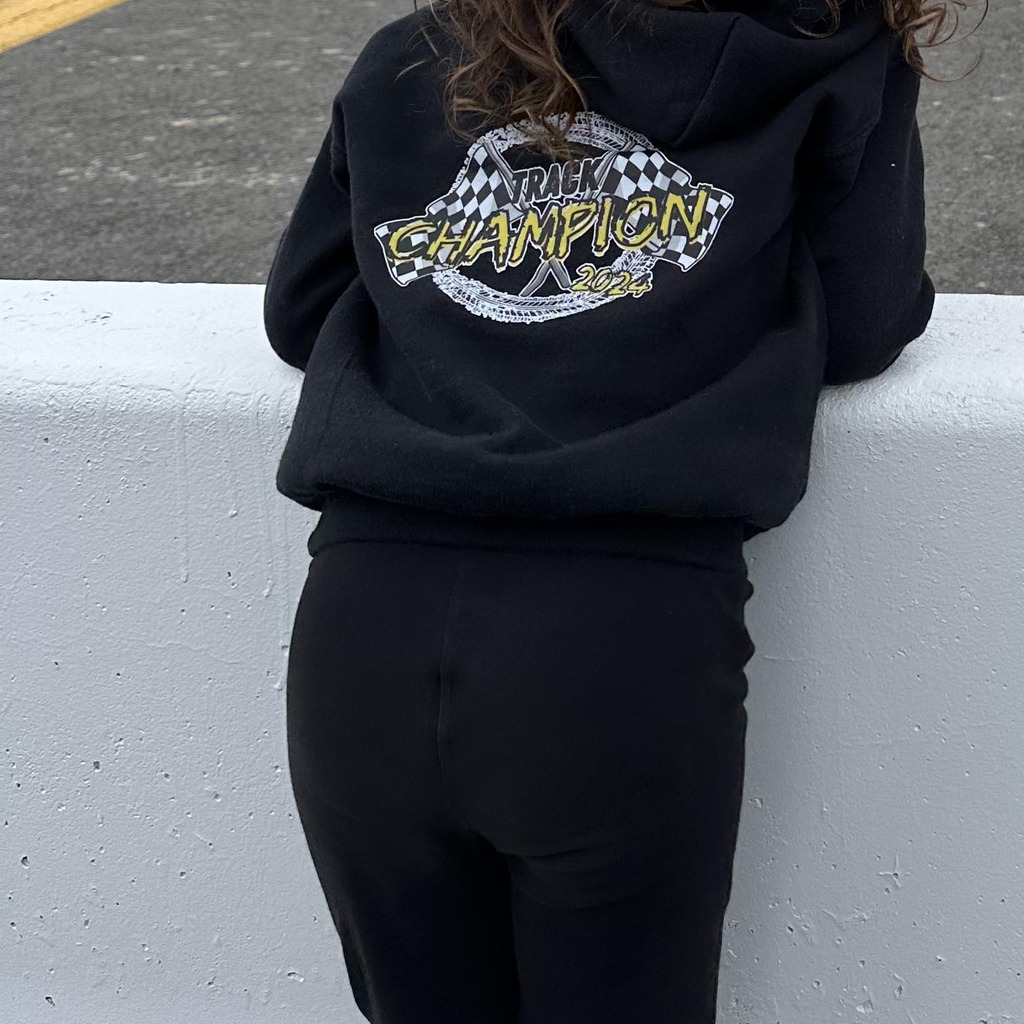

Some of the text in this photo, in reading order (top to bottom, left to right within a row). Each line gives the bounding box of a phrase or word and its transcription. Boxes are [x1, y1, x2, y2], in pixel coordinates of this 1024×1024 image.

[512, 158, 602, 204] TRACK
[386, 187, 710, 271] CHAMPION
[570, 264, 655, 297] 2024
